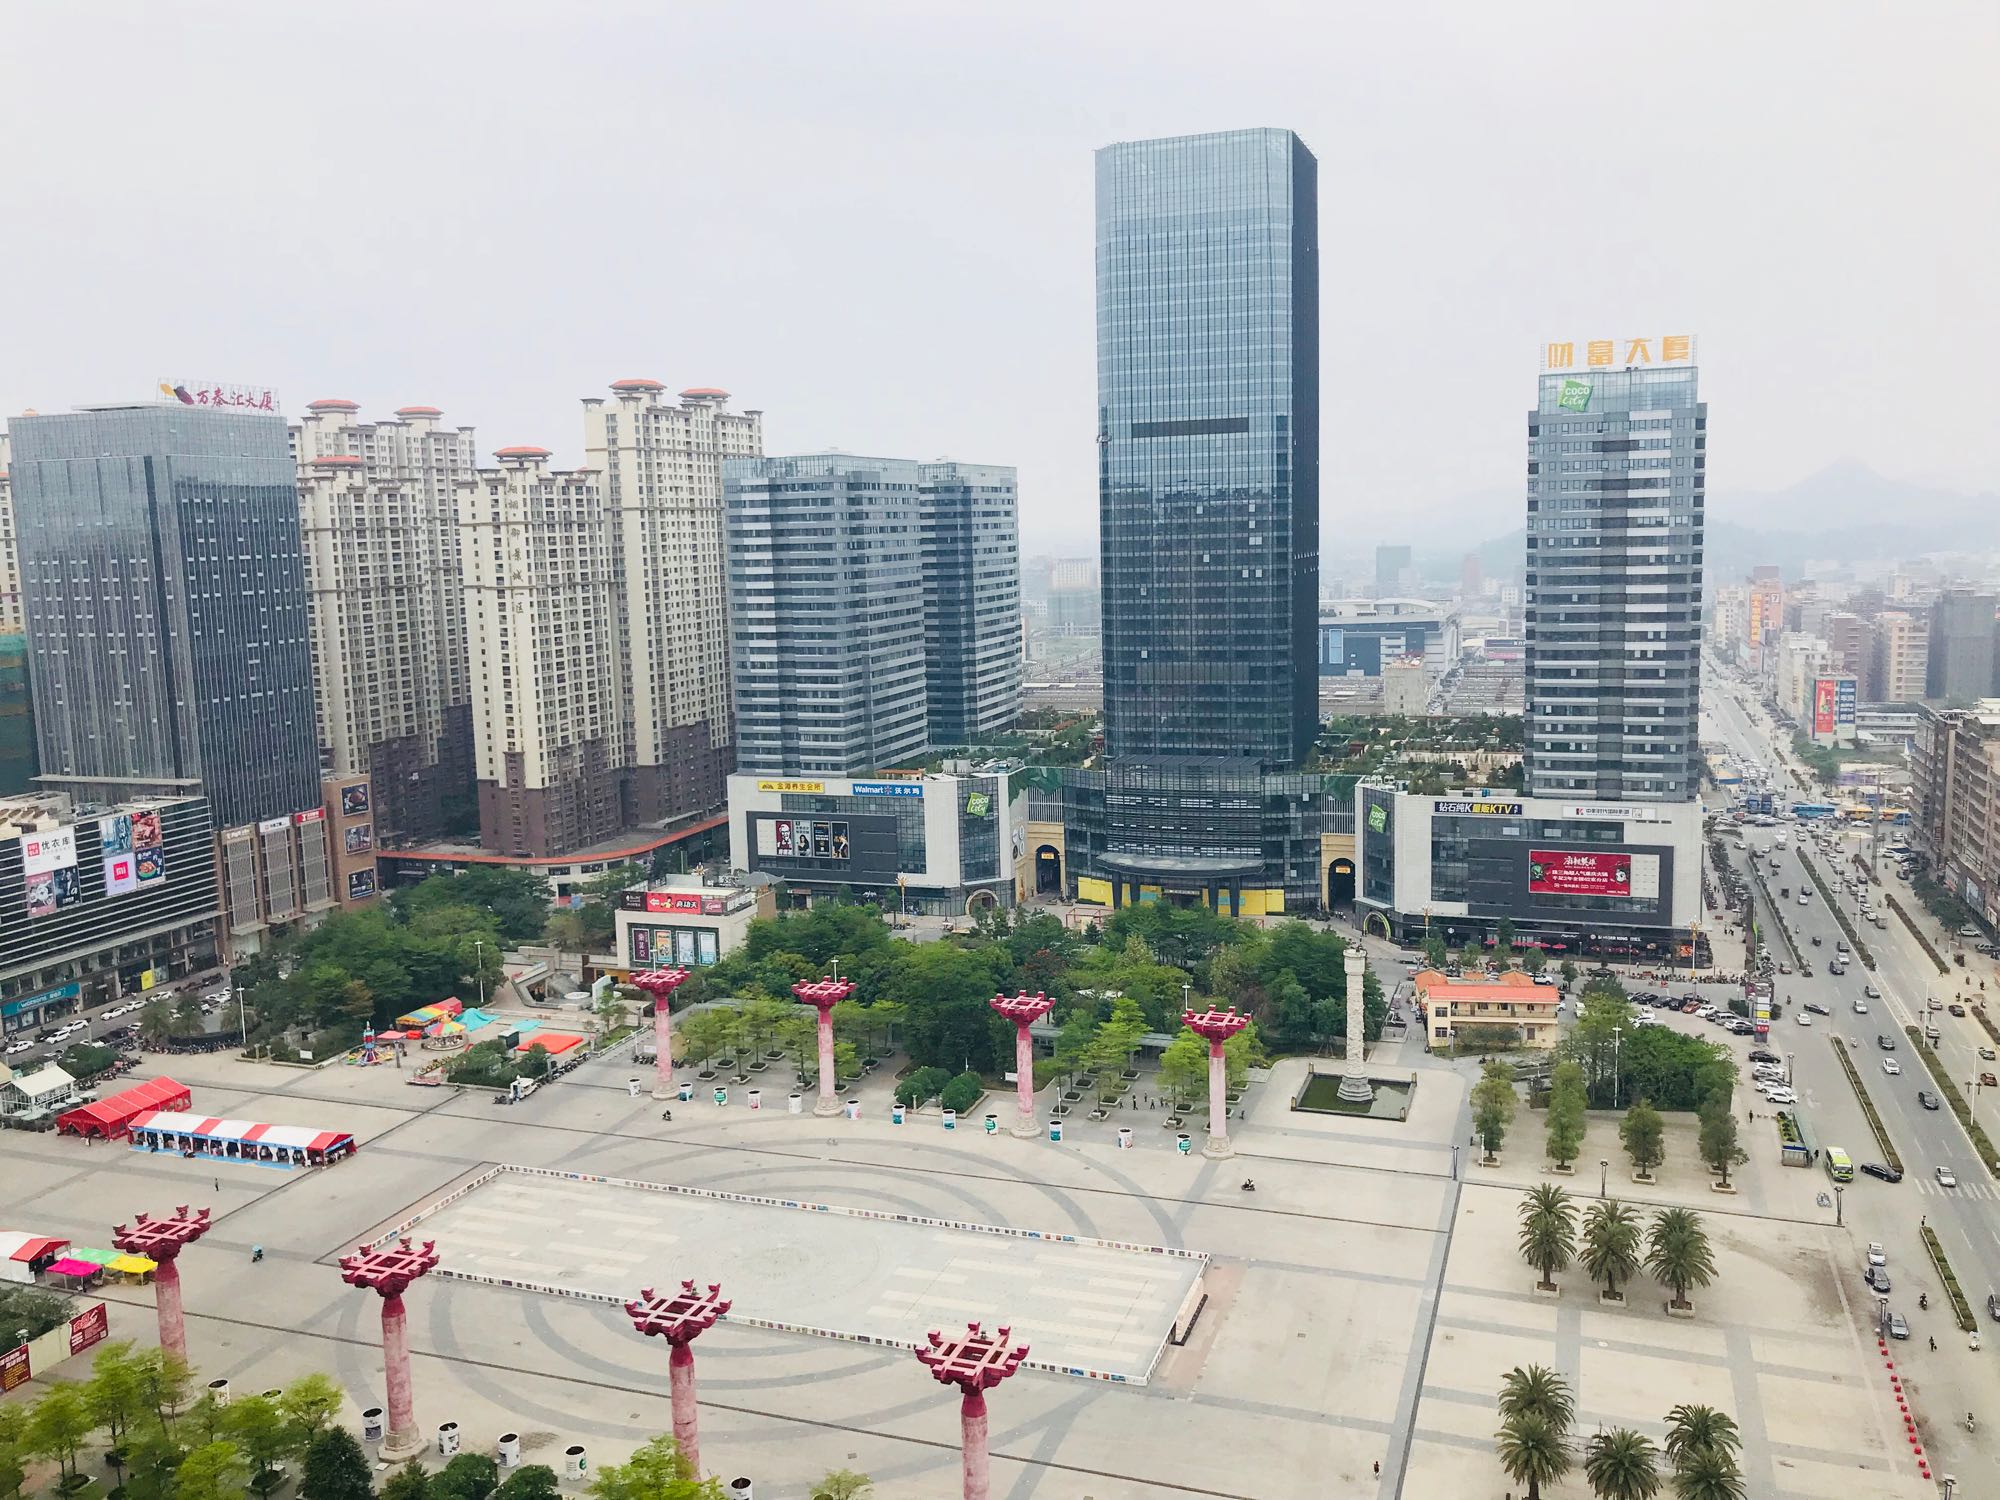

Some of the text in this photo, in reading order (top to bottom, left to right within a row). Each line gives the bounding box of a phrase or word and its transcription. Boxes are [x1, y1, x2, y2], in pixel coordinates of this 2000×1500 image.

[1565, 387, 1590, 396] COCO
[854, 785, 920, 795] Walmart 沃尔玛
[971, 797, 989, 805] COCO
[41, 836, 70, 850] 优衣库
